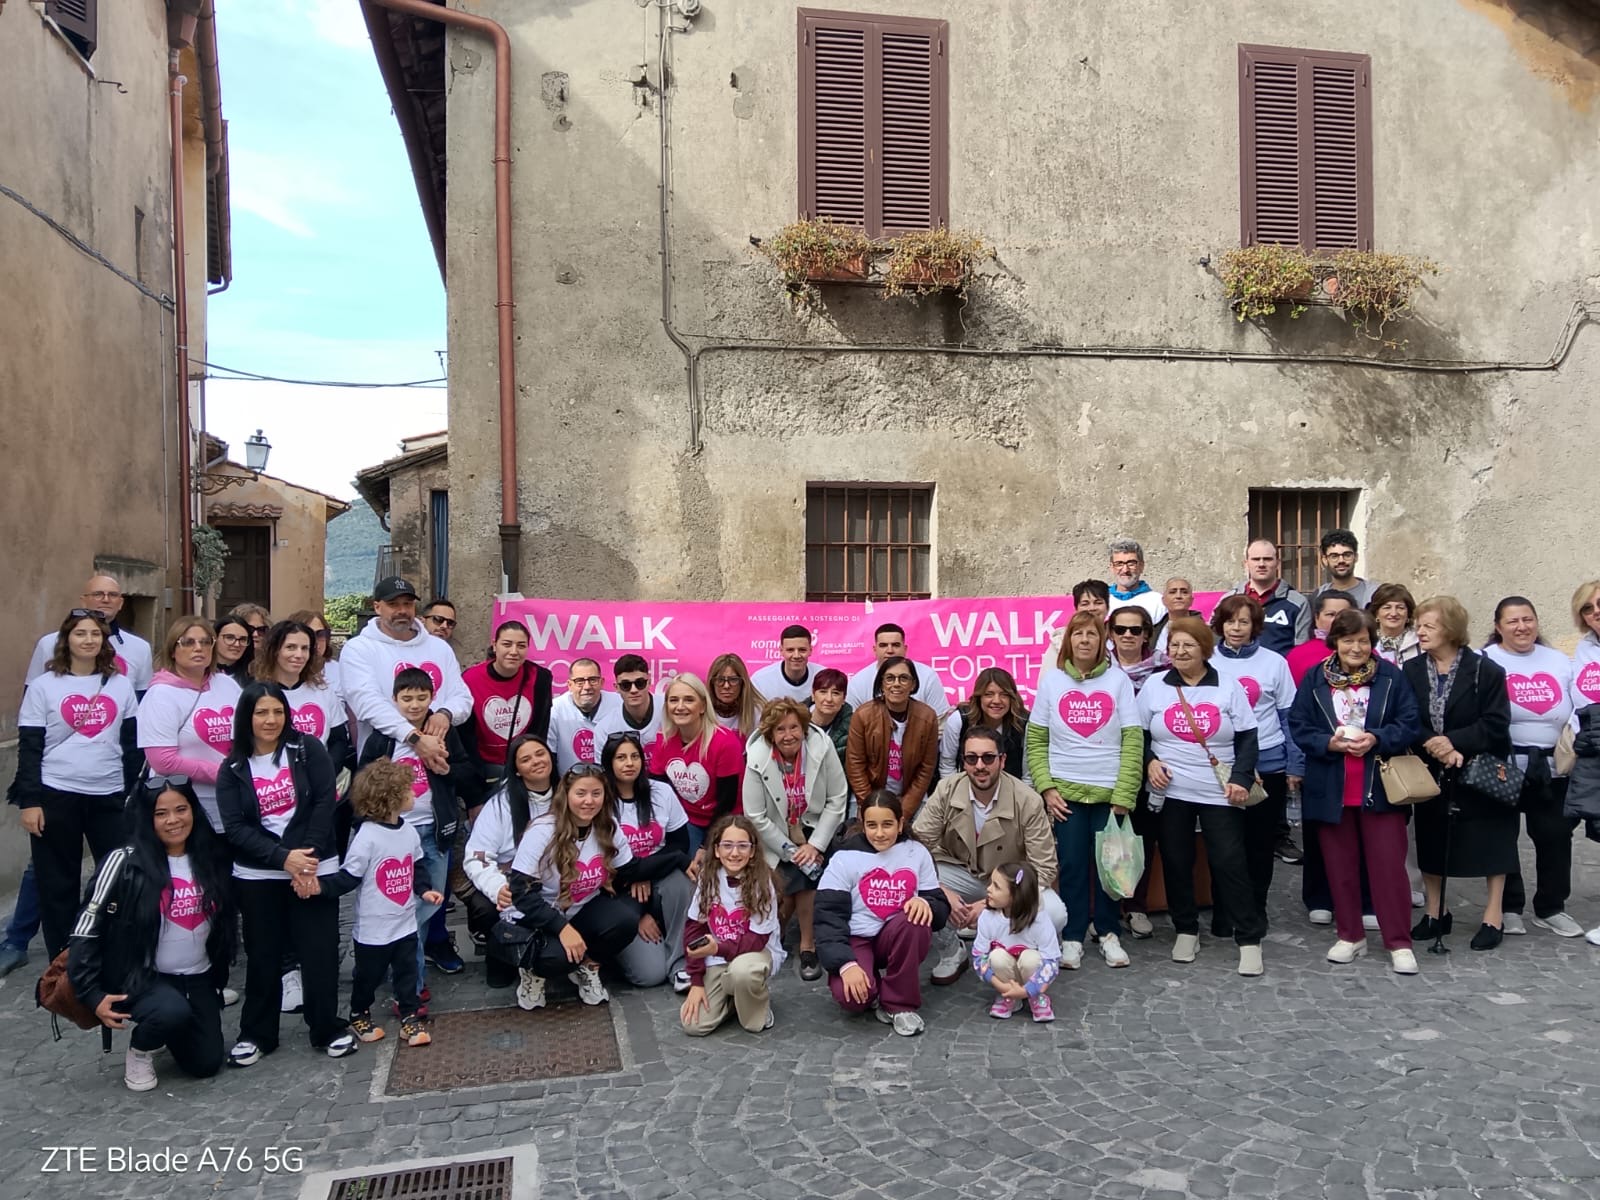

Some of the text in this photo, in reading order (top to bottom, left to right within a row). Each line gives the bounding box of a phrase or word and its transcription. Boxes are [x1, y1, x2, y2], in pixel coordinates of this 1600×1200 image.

[524, 614, 677, 650] WALK
[930, 611, 1063, 647] WALK
[1004, 653, 1043, 679] TH
[1512, 680, 1550, 690] WALK
[1516, 695, 1545, 703] CURE
[1069, 700, 1102, 710] WALK
[1069, 709, 1085, 717] FOR
[293, 713, 315, 724] ALK
[674, 771, 698, 781] WALK
[259, 794, 275, 806] OR
[869, 878, 906, 890] WALK
[867, 888, 887, 898] FOR
[867, 897, 895, 906] CURE
